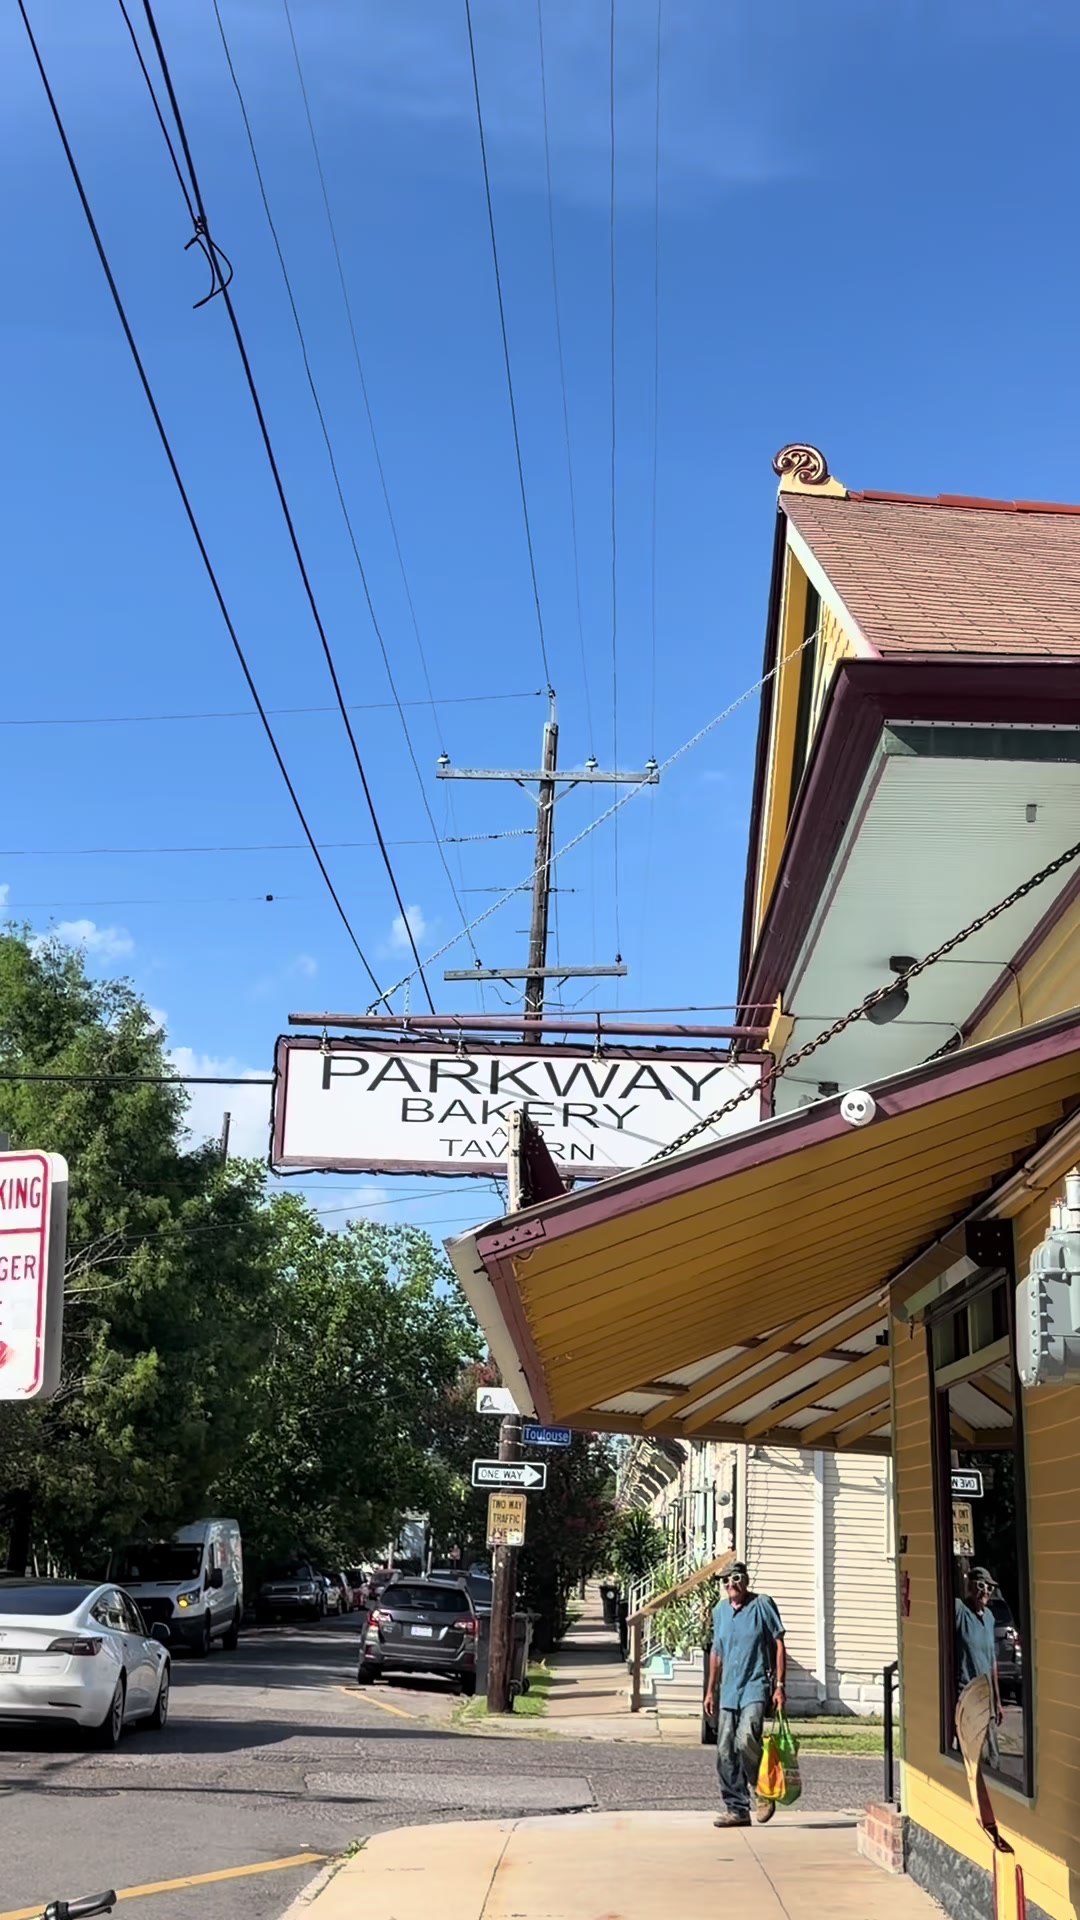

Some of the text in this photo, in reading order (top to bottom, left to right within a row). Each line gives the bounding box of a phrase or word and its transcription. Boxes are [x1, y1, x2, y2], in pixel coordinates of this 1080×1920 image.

[321, 1055, 724, 1102] PARKWAY
[401, 1097, 640, 1129] BAKERY
[439, 1138, 595, 1161] TAVRN
[525, 1427, 569, 1442] Toulouse
[481, 1469, 523, 1480] ONE WAY
[492, 1499, 522, 1510] TWO WAY
[493, 1513, 521, 1524] TRAFFIC
